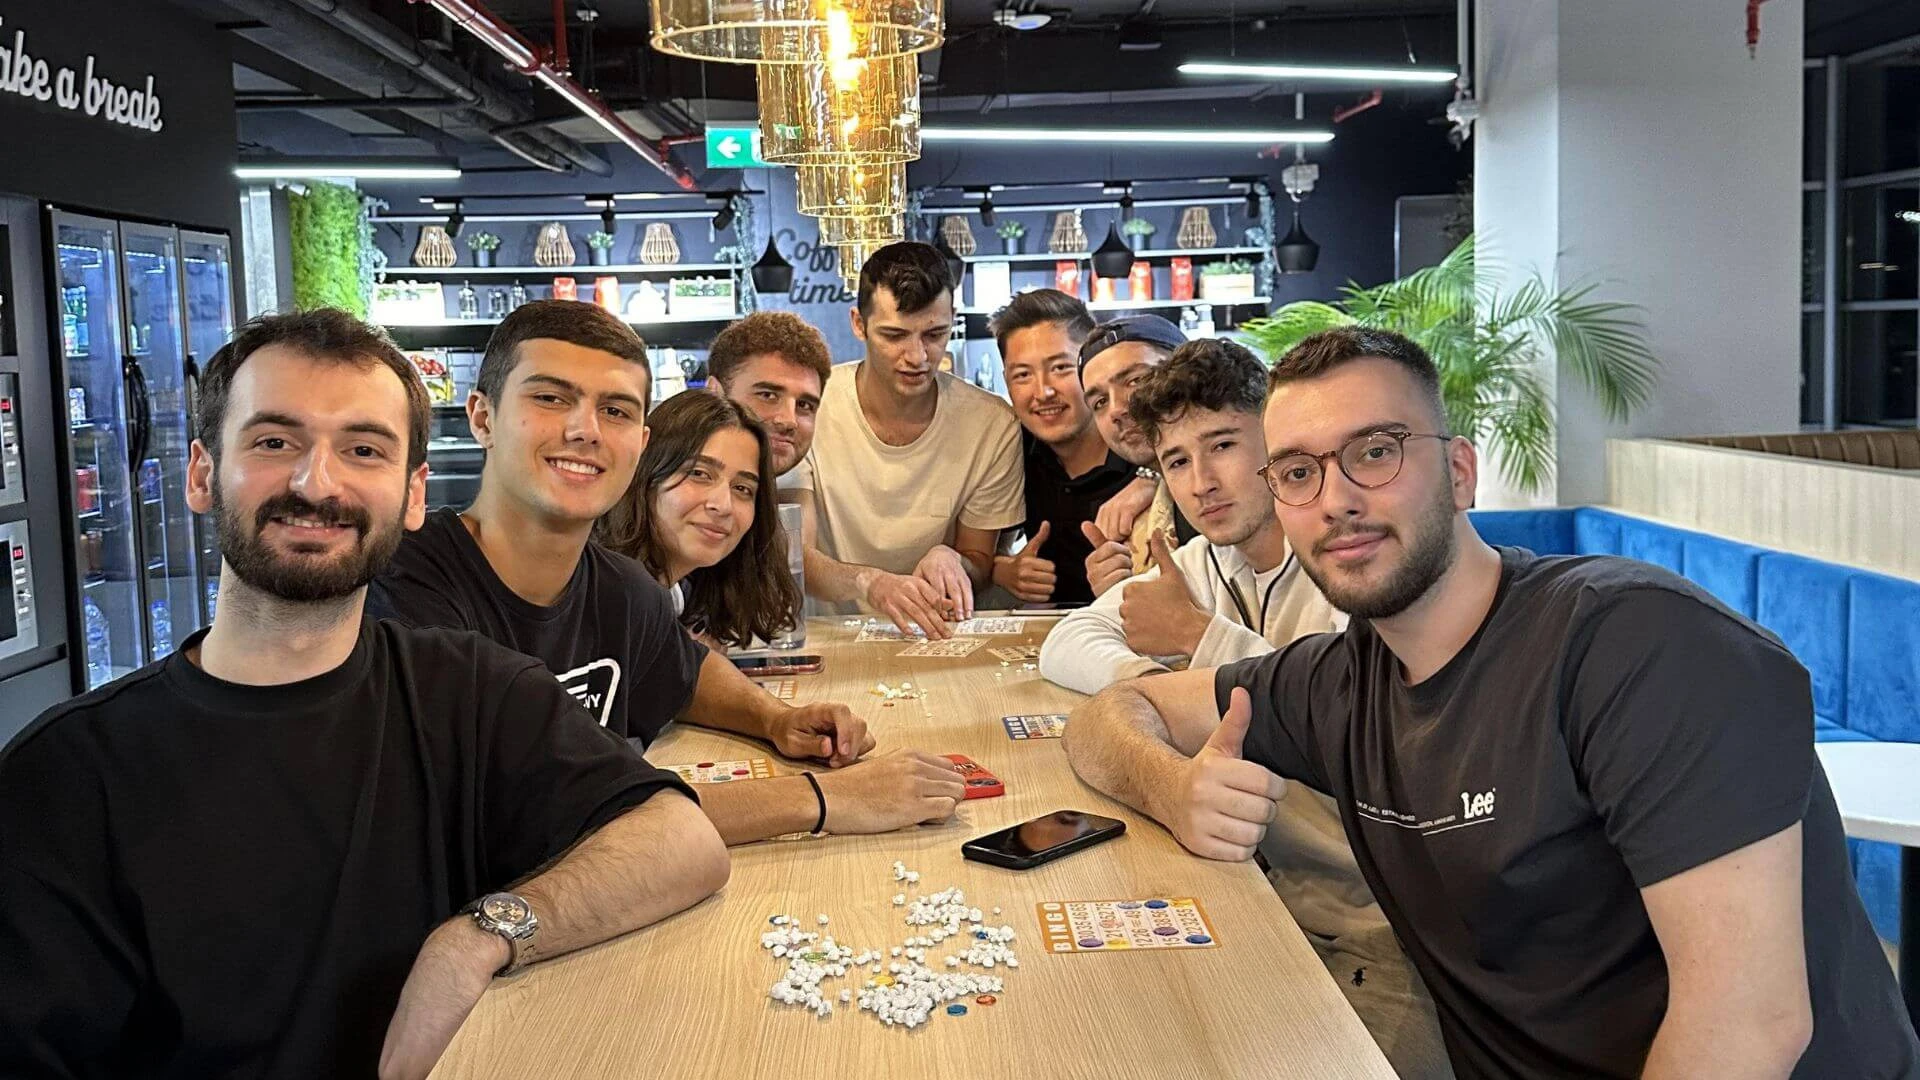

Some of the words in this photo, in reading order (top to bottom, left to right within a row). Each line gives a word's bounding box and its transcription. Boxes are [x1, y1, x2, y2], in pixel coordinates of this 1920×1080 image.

[0, 29, 52, 101] ake
[55, 67, 80, 109] a
[84, 55, 163, 132] break
[789, 277, 857, 304] time
[1461, 791, 1495, 819] Lee
[1043, 902, 1072, 951] BINGO
